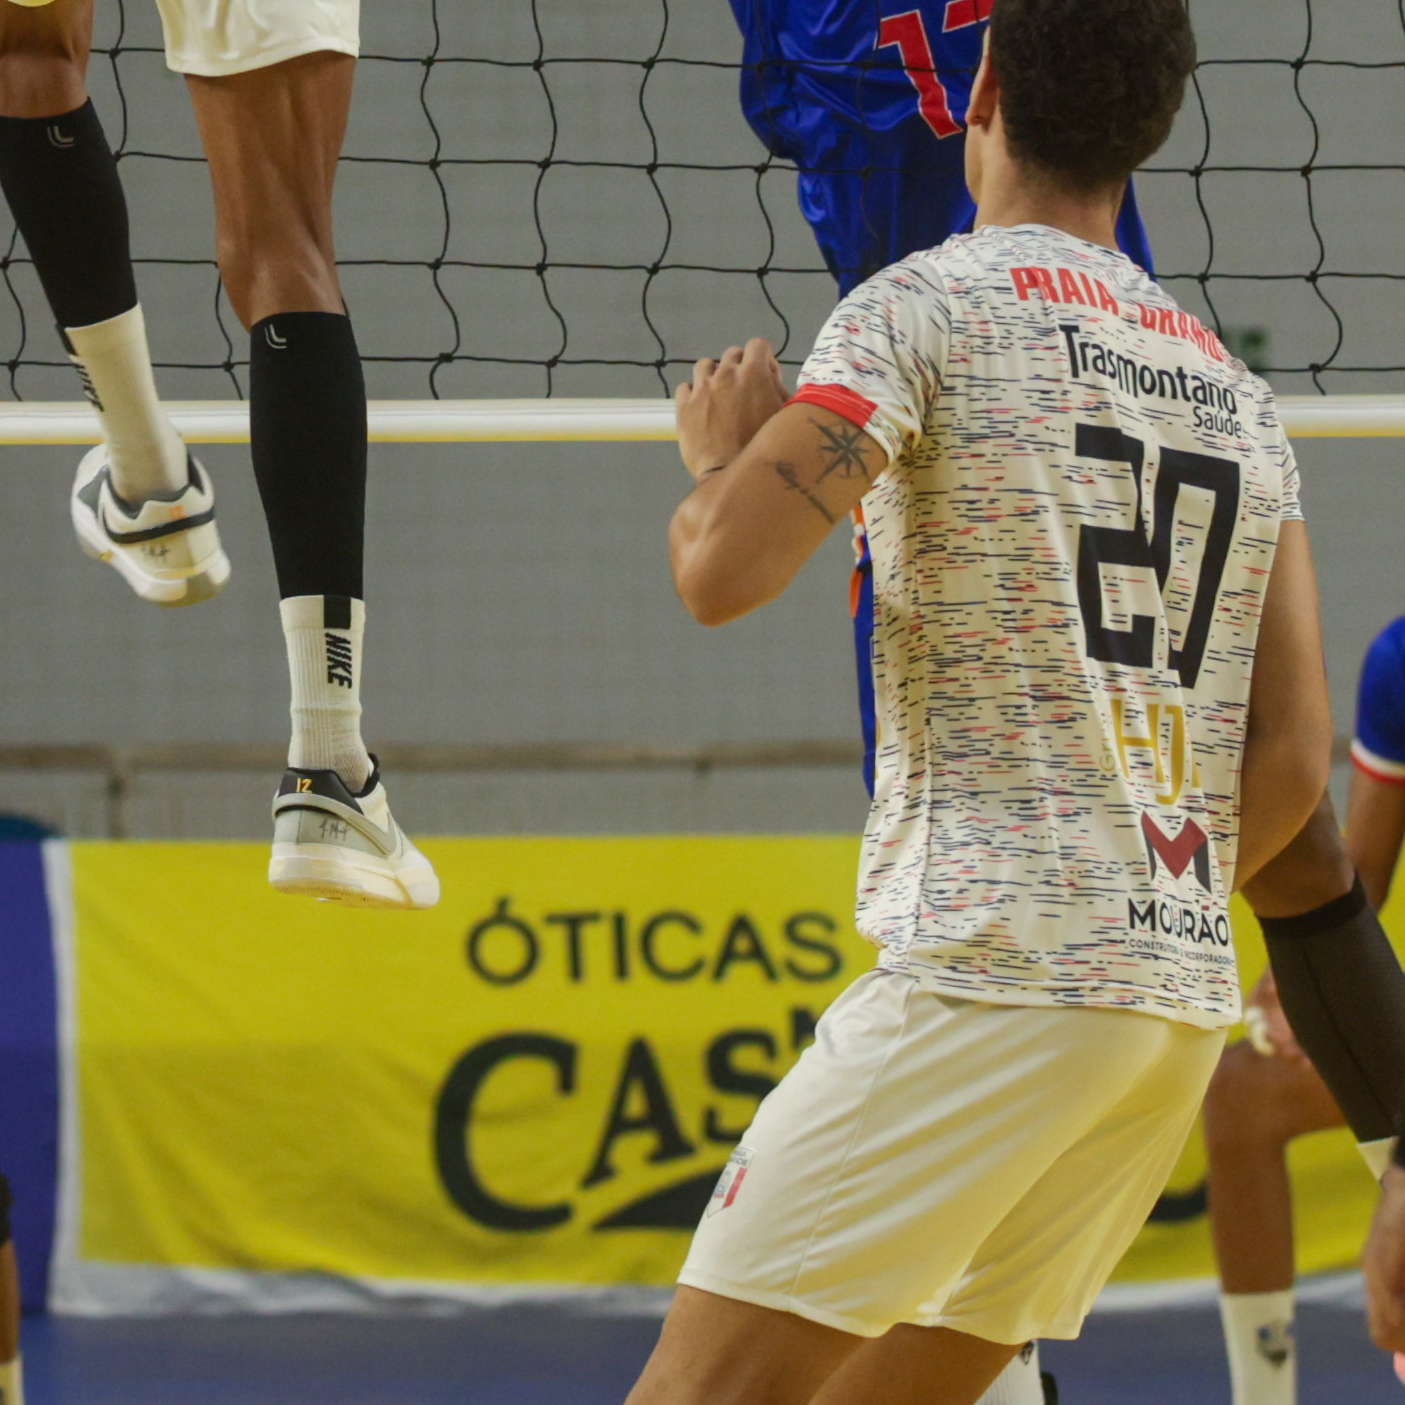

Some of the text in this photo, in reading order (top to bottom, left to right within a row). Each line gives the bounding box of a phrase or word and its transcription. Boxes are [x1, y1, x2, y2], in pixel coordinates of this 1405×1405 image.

[1010, 266, 1120, 316] PRAIA
[1059, 324, 1238, 415] Trasmontano
[1193, 405, 1242, 439] Saúde
[1075, 423, 1240, 690] 20
[325, 632, 352, 689] NIKE
[464, 895, 845, 987] ÓTICAS
